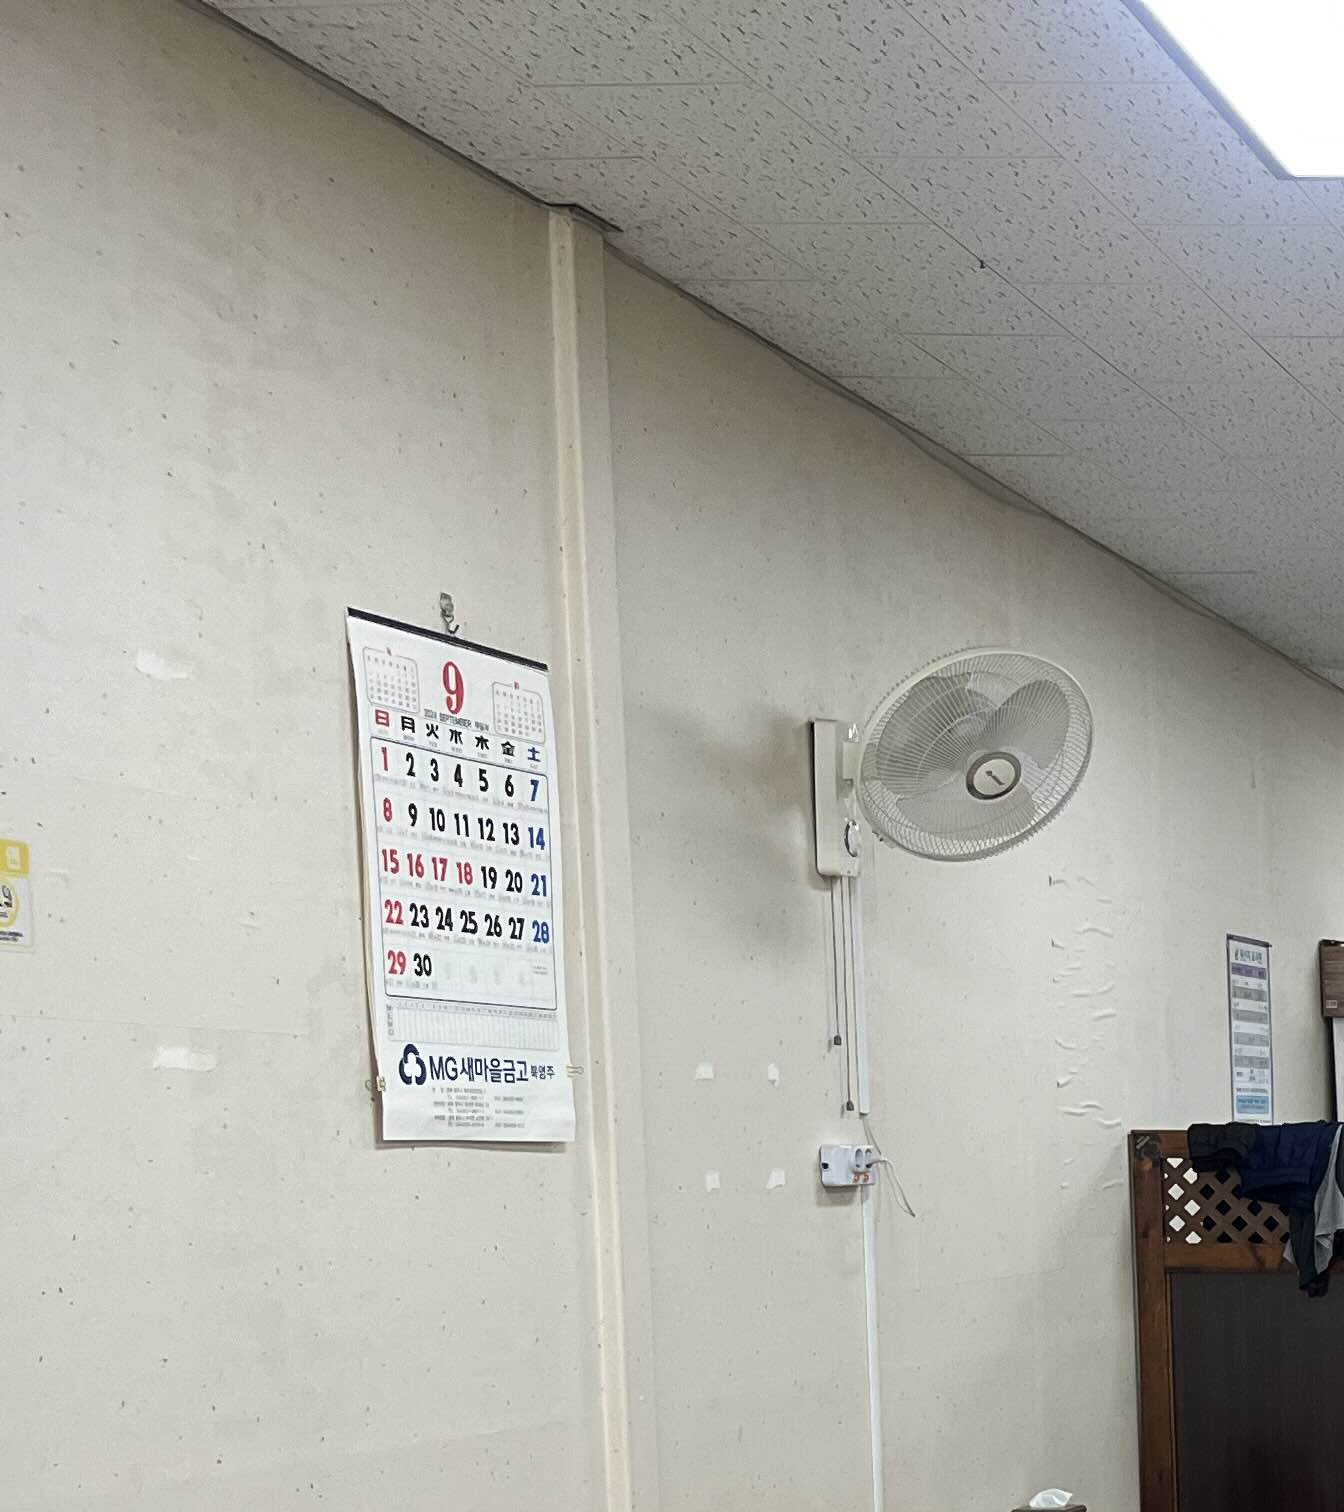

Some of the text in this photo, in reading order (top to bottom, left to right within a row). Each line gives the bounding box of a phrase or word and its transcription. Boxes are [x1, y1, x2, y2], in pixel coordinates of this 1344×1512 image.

[442, 661, 464, 714] 9
[375, 709, 389, 727] 日
[401, 716, 415, 733] 月
[425, 723, 439, 739] 火
[475, 735, 489, 750] 木
[501, 741, 515, 756] 金
[528, 747, 541, 762] 土
[381, 746, 539, 801] 1 2 3 4 5 6 7
[383, 797, 545, 850] 8 9 10 11 12 13 14
[382, 849, 547, 897] 15 16 17 18 19 20 21
[384, 899, 549, 944] 22 23 24 25 26 27 28
[387, 950, 432, 977] 29 30
[429, 1056, 458, 1081] MG
[460, 1056, 528, 1084] 새마을금고
